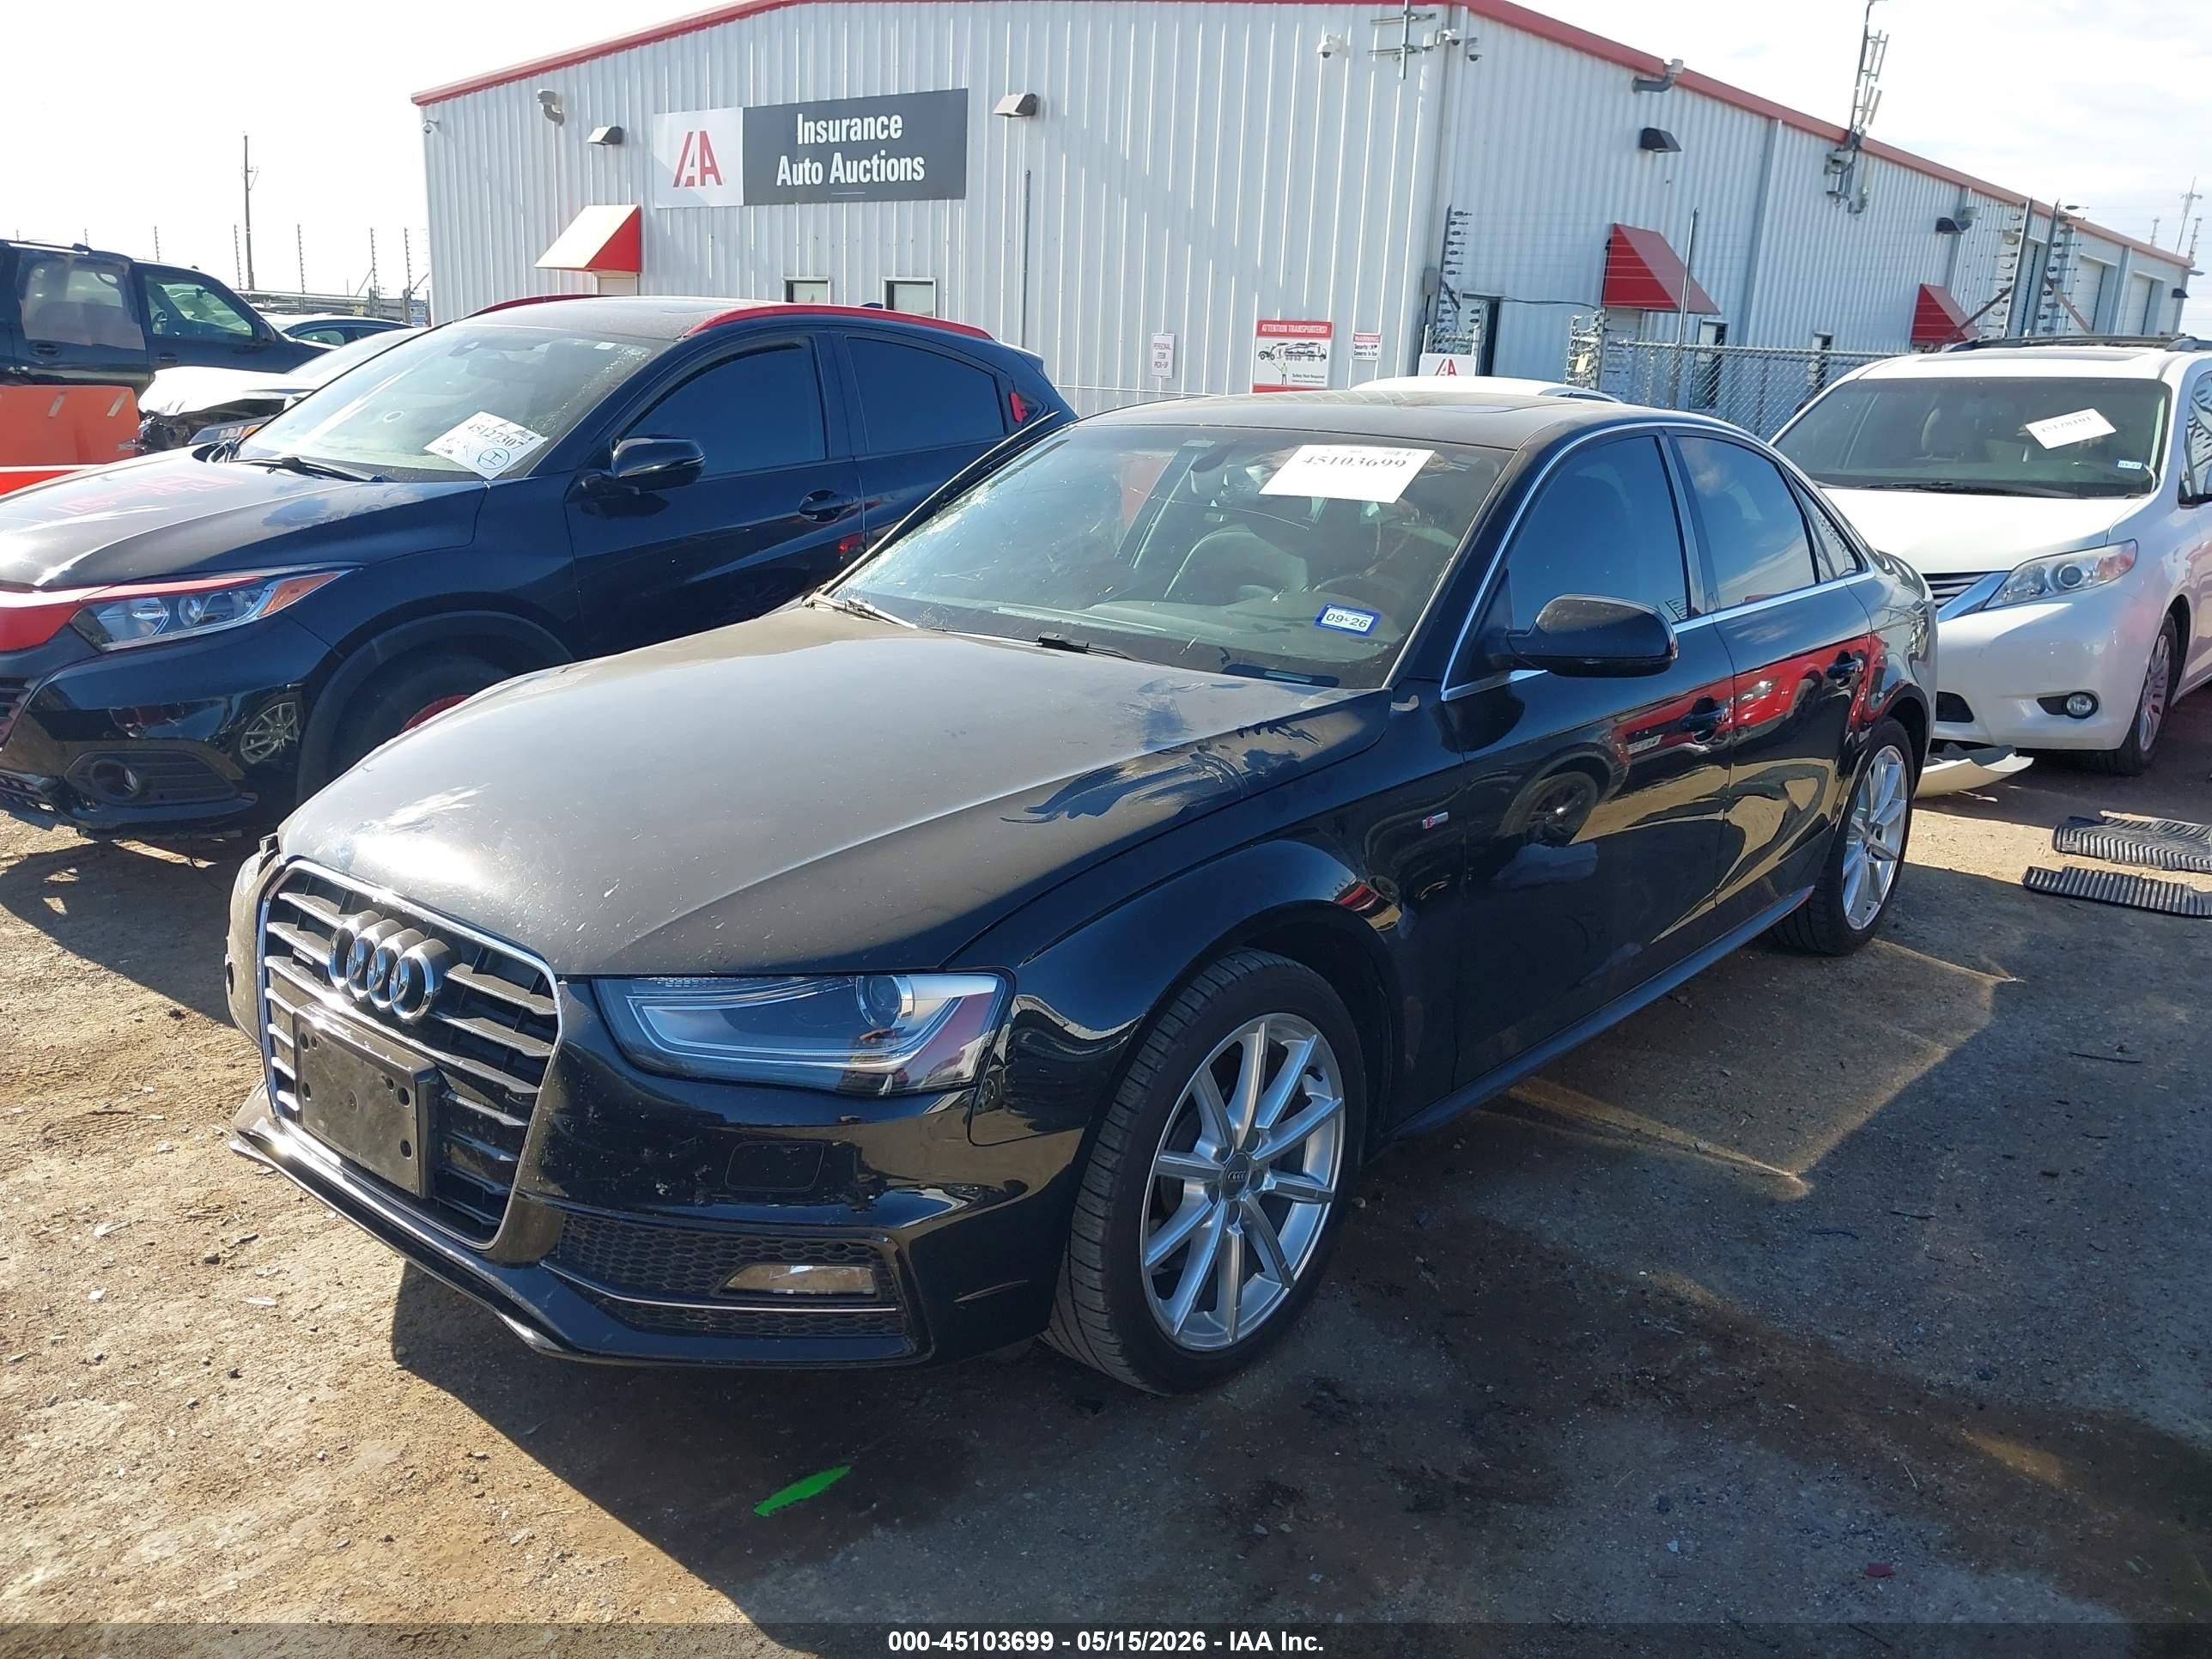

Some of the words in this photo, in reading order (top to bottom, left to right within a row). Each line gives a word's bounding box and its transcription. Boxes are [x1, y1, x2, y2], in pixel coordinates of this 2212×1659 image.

[797, 113, 902, 144] Insurance
[776, 155, 823, 186] Auto
[829, 149, 926, 185] Auctions
[467, 423, 523, 450] 45127307
[1301, 455, 1407, 469] 45103699
